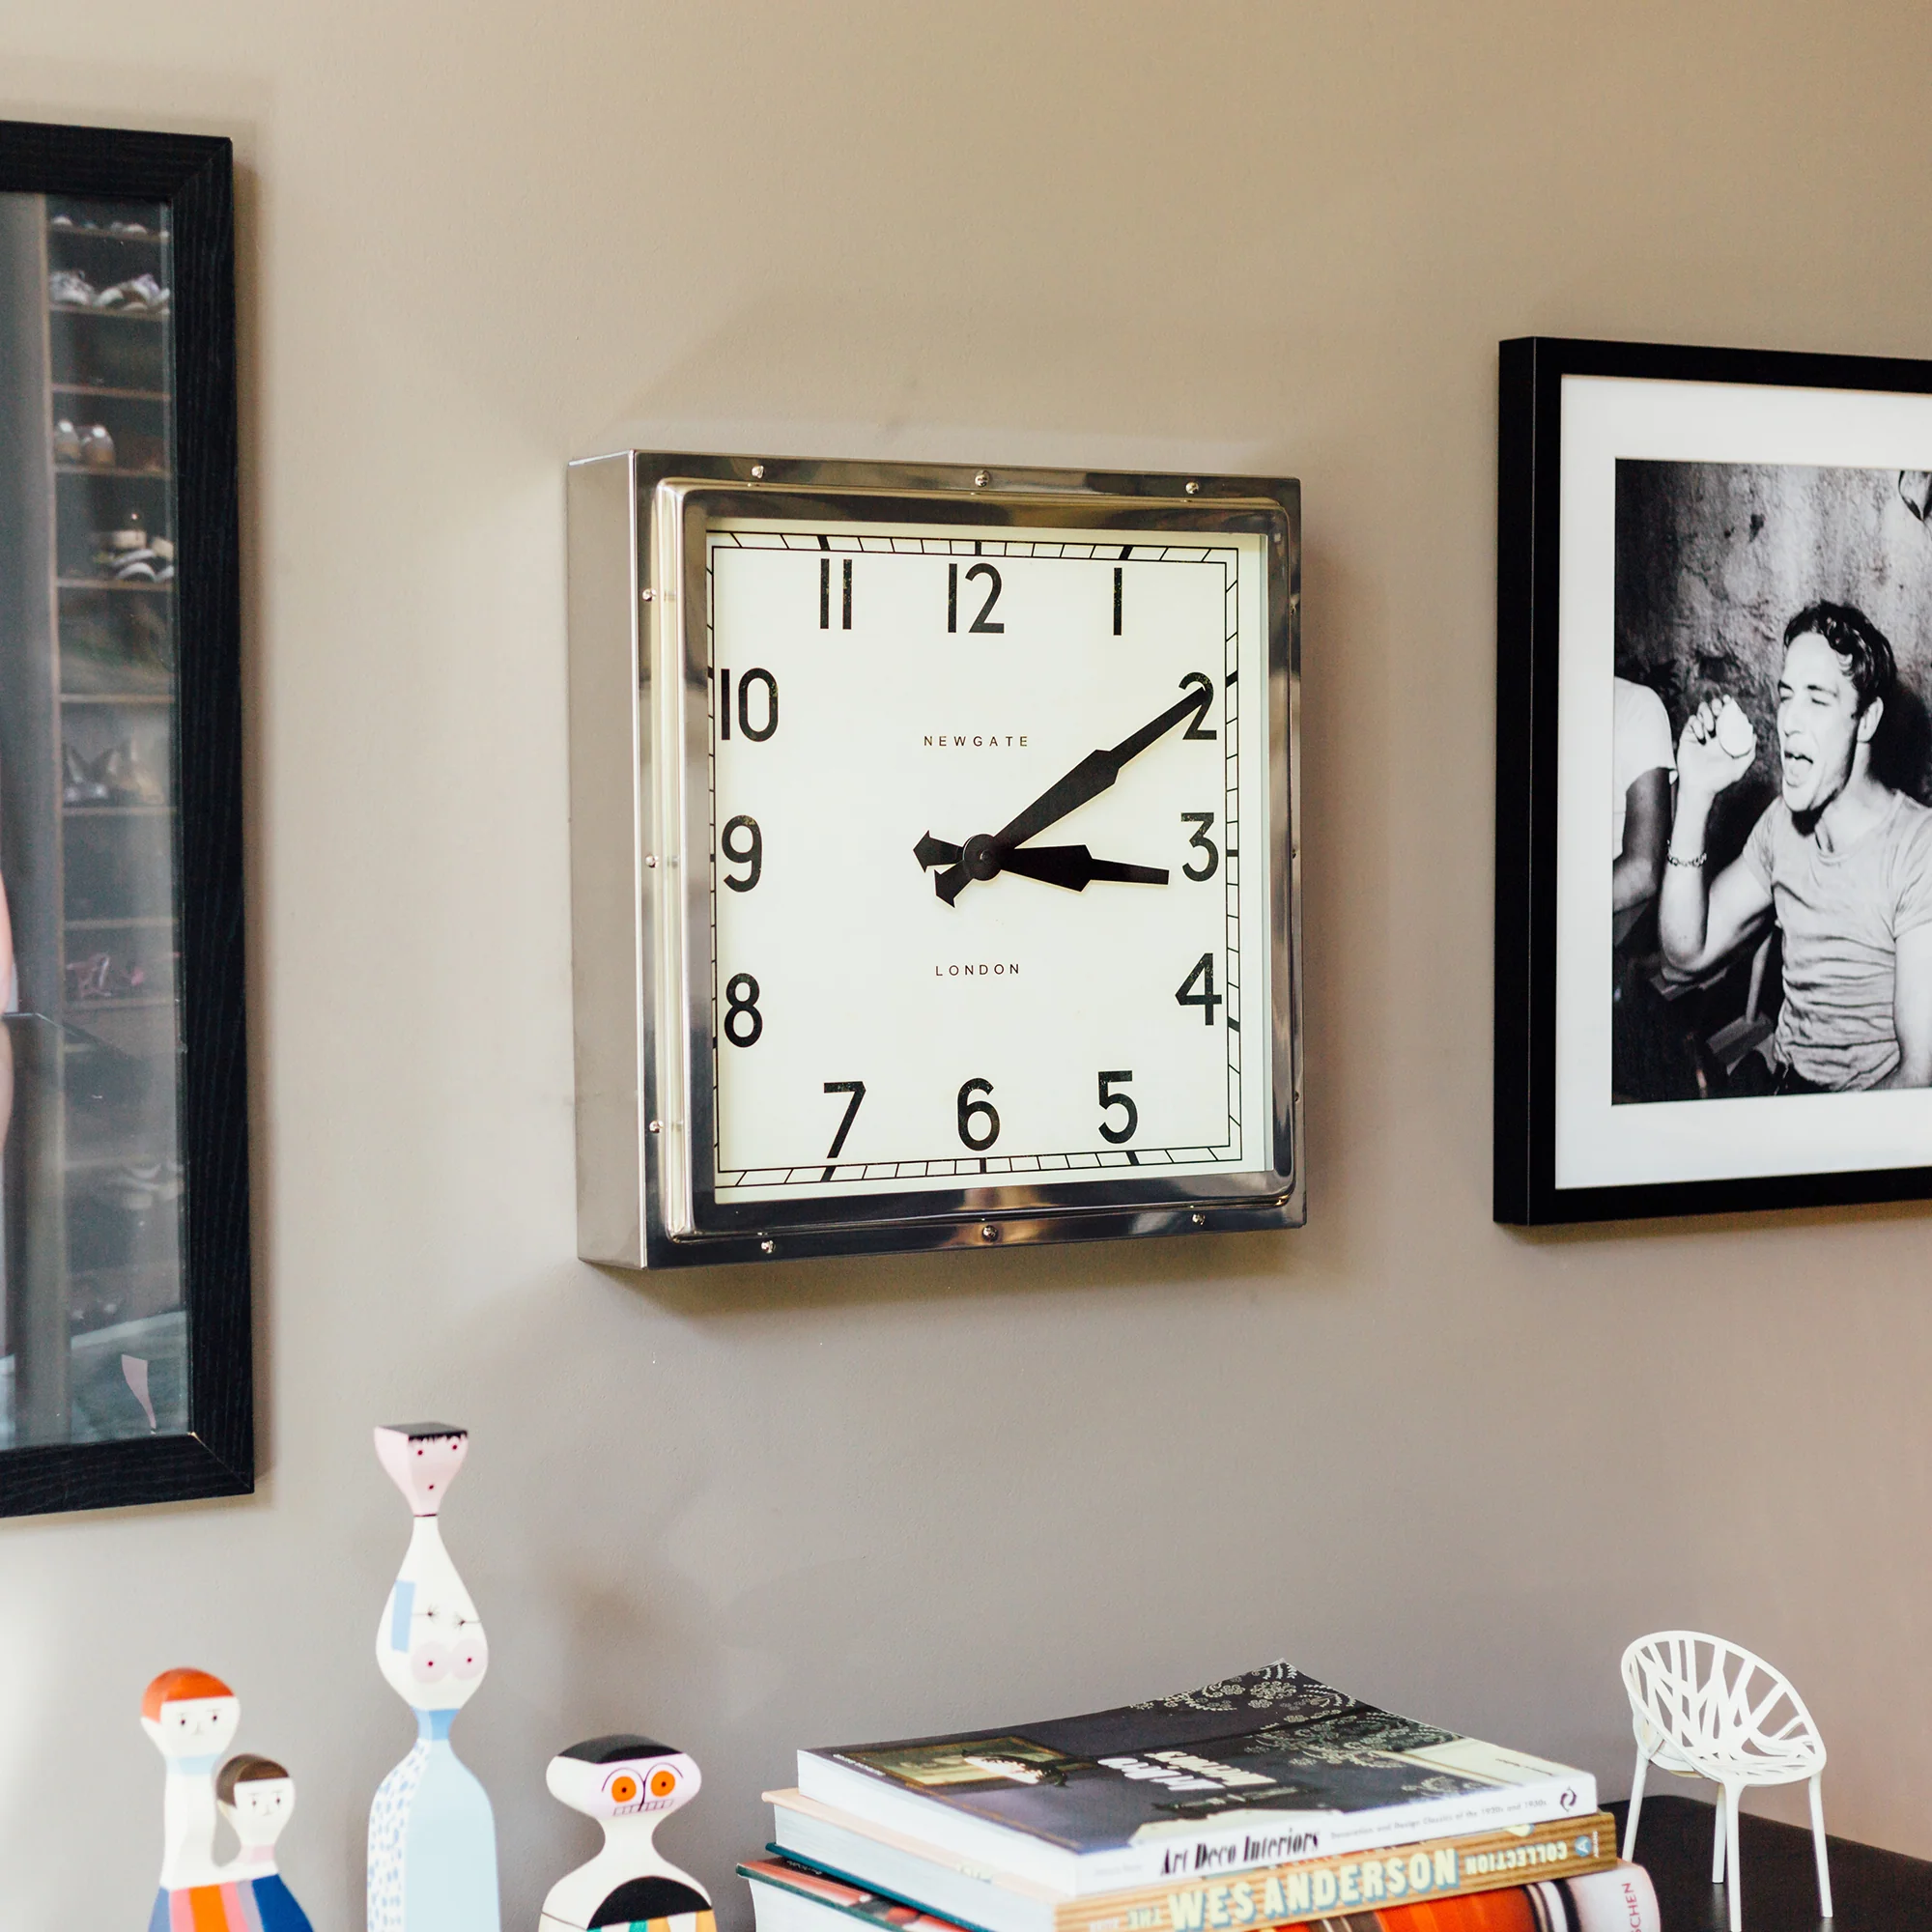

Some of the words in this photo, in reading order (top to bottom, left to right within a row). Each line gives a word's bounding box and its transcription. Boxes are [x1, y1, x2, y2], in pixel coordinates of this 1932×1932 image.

[820, 558, 852, 629] 11
[949, 563, 1005, 633] 12
[1114, 568, 1122, 636] 1
[721, 668, 779, 742] 10
[1178, 671, 1217, 740] 2
[923, 735, 1028, 748] NEWGATE
[722, 815, 762, 892] 9
[1181, 812, 1218, 881] 3
[935, 963, 1020, 977] LONDON
[1176, 953, 1222, 1025] 4
[724, 974, 762, 1047] 8
[824, 1081, 866, 1158] 7
[957, 1078, 1000, 1151] 6
[1098, 1070, 1138, 1144] 5
[1161, 1848, 1188, 1875] Art
[1195, 1842, 1237, 1869] Deco
[1243, 1827, 1321, 1862] Interiors
[1464, 1840, 1568, 1875] COLLECTION
[1167, 1882, 1255, 1932] WES
[1264, 1847, 1460, 1919] ANDERSON
